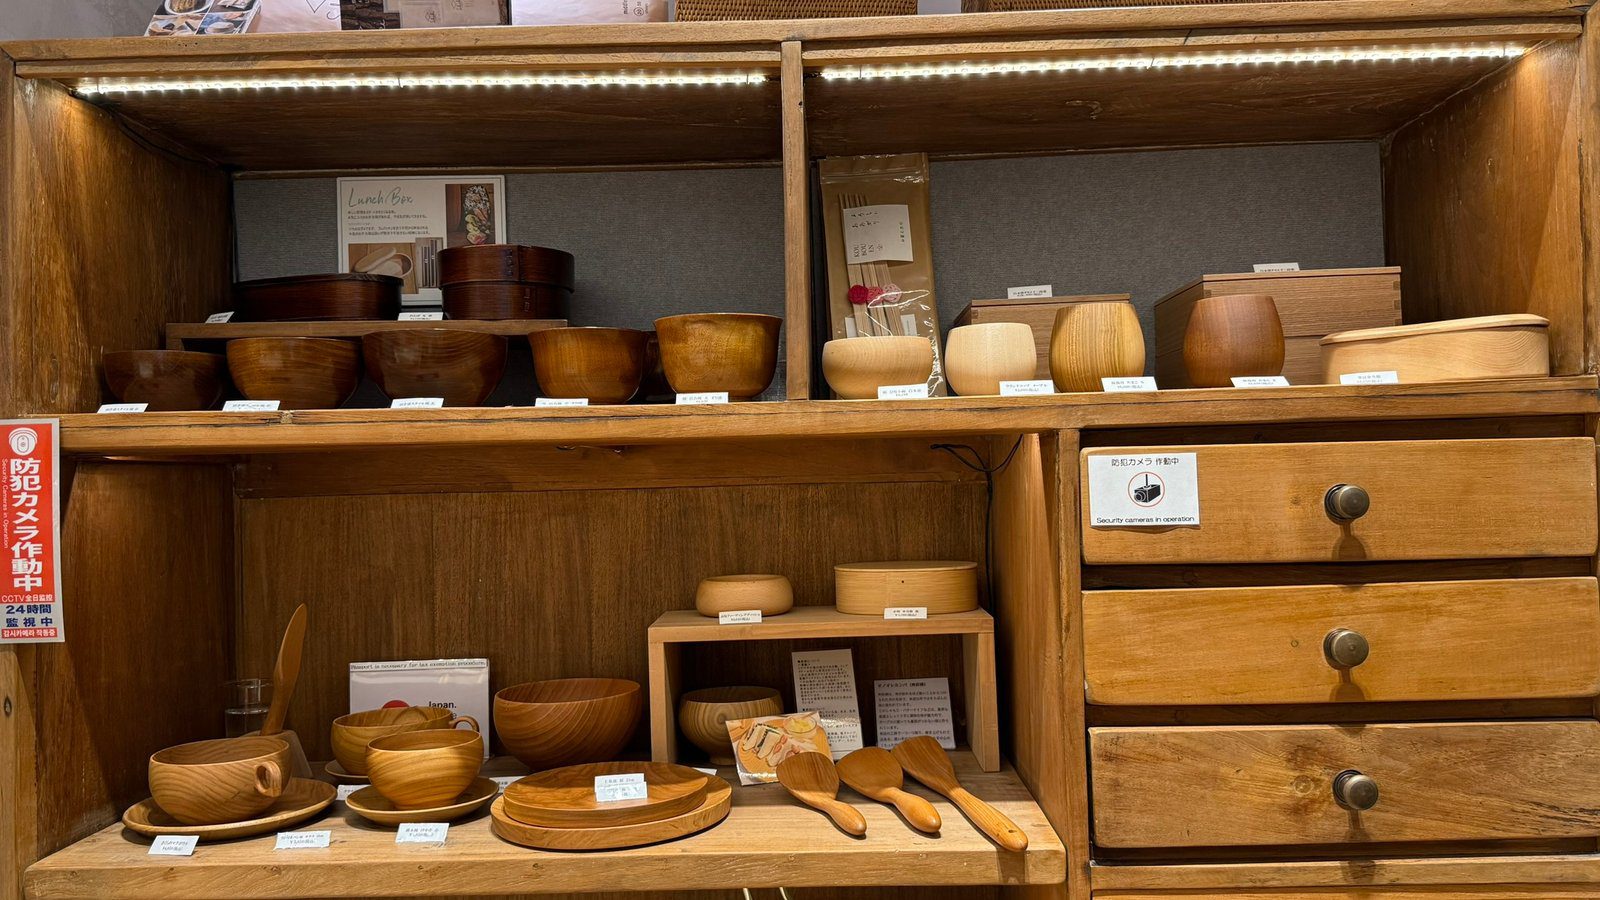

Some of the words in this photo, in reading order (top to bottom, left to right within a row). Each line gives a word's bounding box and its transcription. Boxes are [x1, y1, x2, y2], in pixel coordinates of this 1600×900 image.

[348, 187, 384, 208] Lunch
[385, 186, 413, 207] Box
[1111, 458, 1152, 467] 防犯カメラ
[1155, 457, 1179, 466] 作動中
[10, 457, 42, 592] 防犯カメラ作動中
[5, 604, 52, 614] 24時間
[3, 629, 35, 638] 감시카메라
